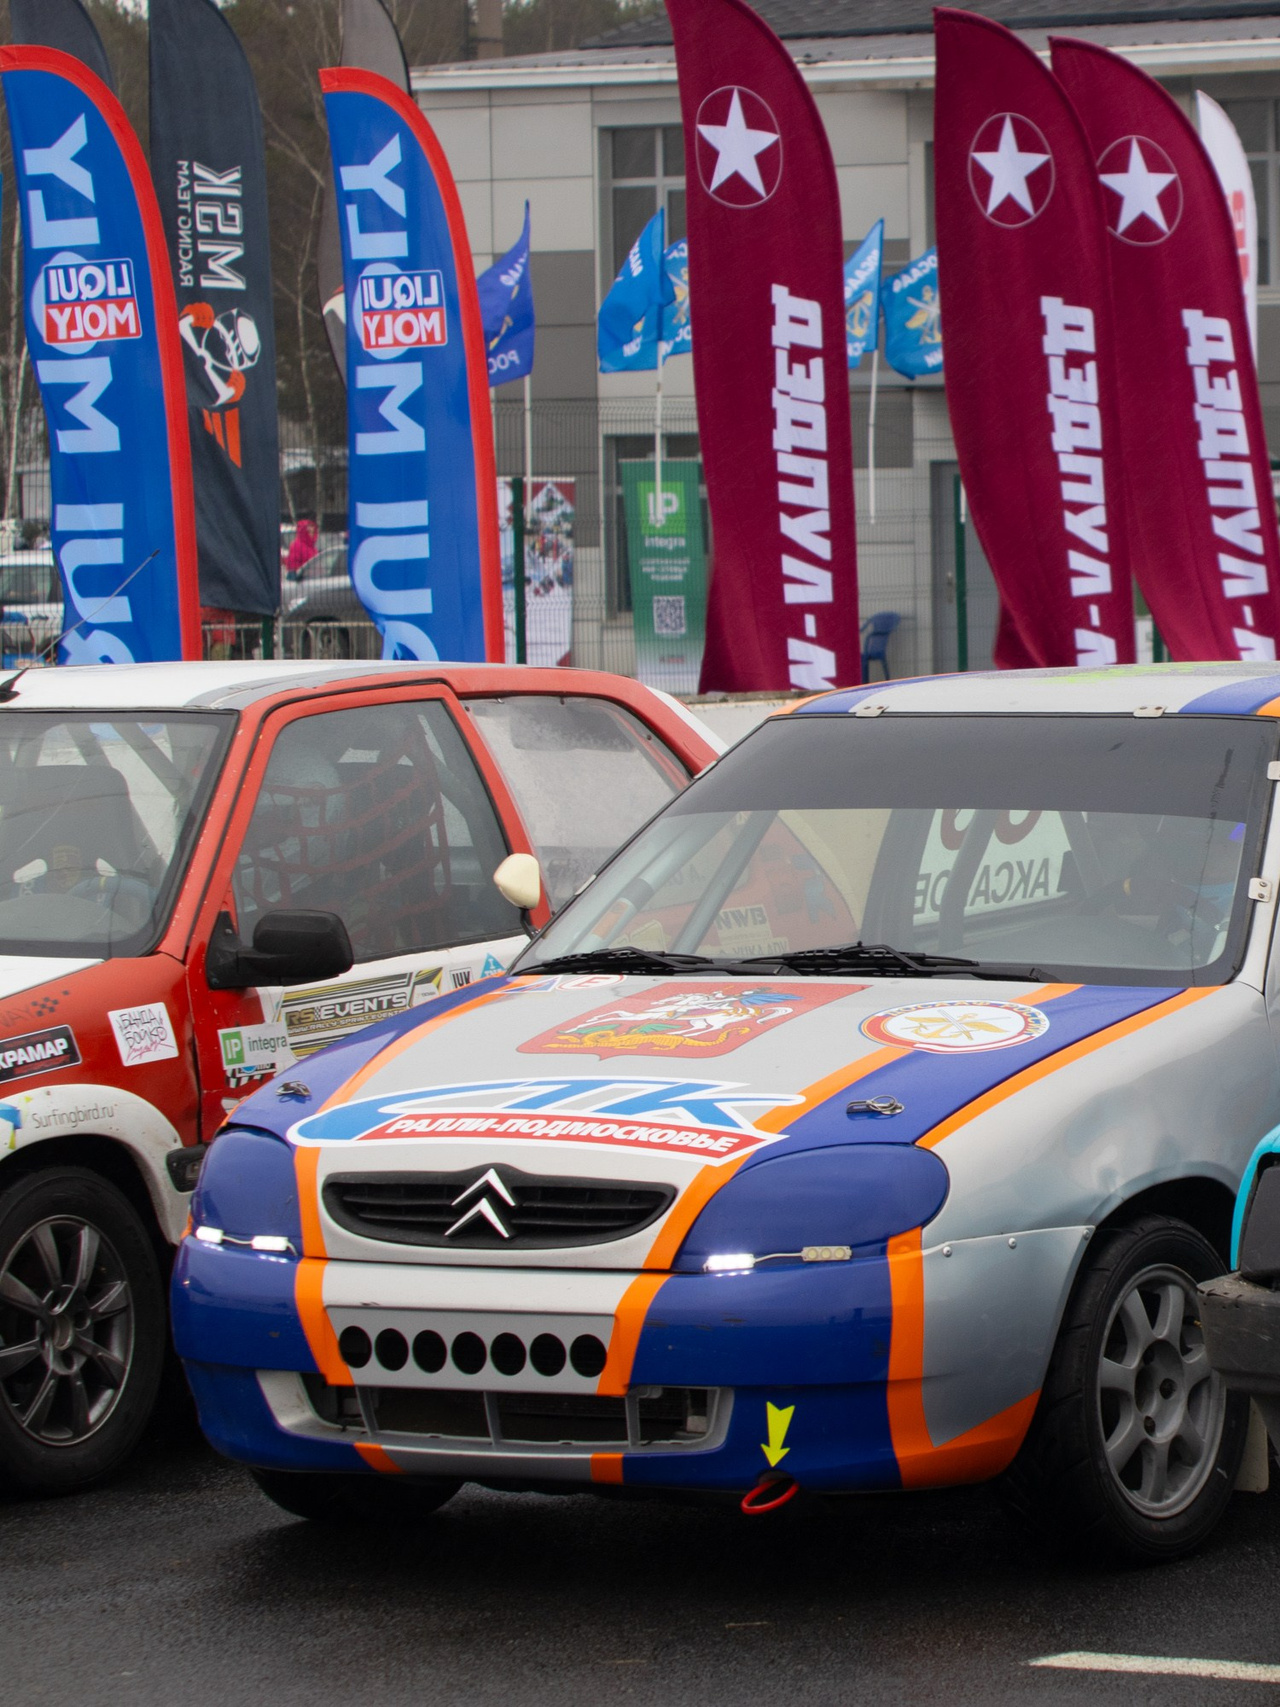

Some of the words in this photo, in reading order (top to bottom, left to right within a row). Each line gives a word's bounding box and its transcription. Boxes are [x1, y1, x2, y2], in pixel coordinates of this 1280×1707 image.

[285, 1008, 315, 1026] RS
[320, 992, 408, 1020] EVENTS
[225, 1038, 241, 1060] IP
[247, 1034, 288, 1055] integra
[32, 1104, 115, 1130] Surfingbird.ru
[386, 1117, 740, 1153] РАЛЛИ-ПОДМОСКОВЬЕ
